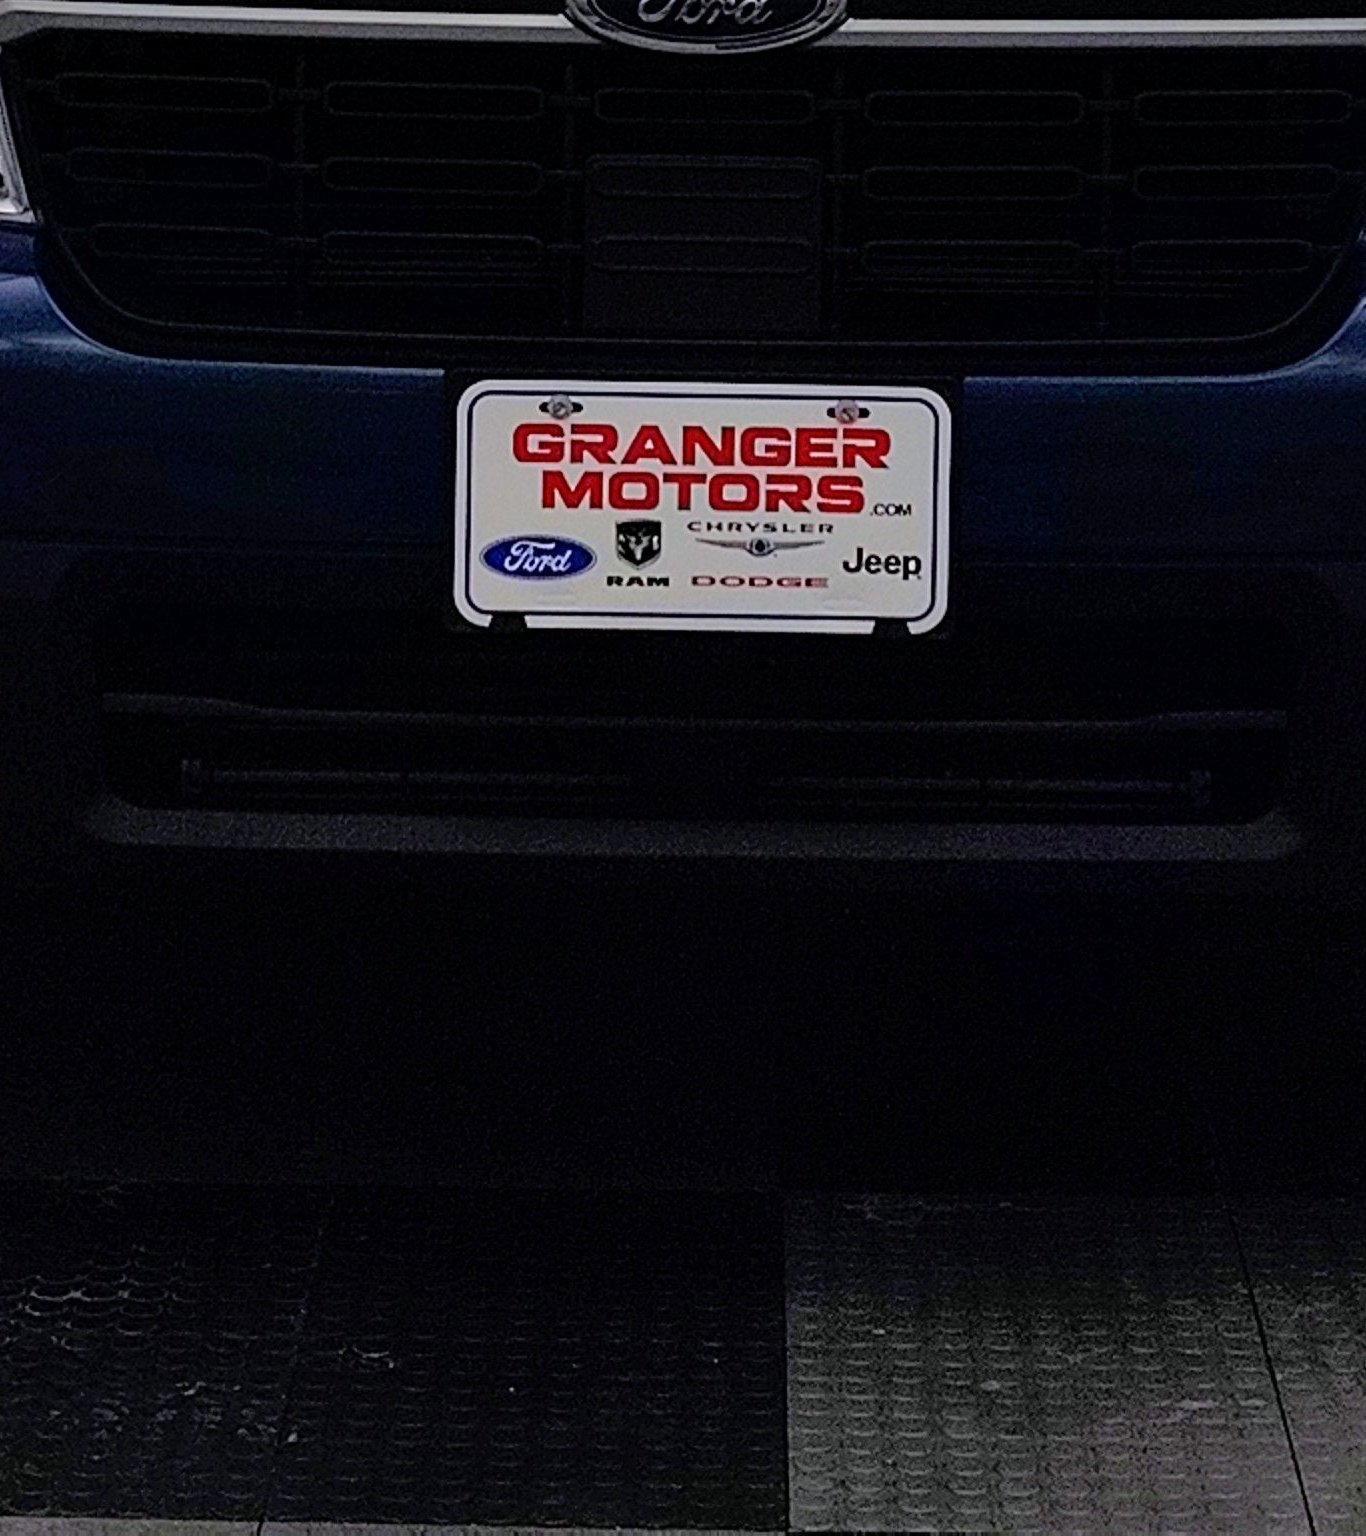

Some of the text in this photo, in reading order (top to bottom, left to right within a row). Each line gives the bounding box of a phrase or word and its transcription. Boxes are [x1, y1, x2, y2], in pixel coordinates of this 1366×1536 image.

[513, 423, 891, 469] GRANGER
[541, 471, 866, 515] MOTORS
[687, 521, 834, 533] CHRYSLER
[503, 542, 573, 573] Ford
[842, 547, 922, 580] Jeep
[606, 575, 670, 587] RAM
[691, 575, 829, 588] DODGE
